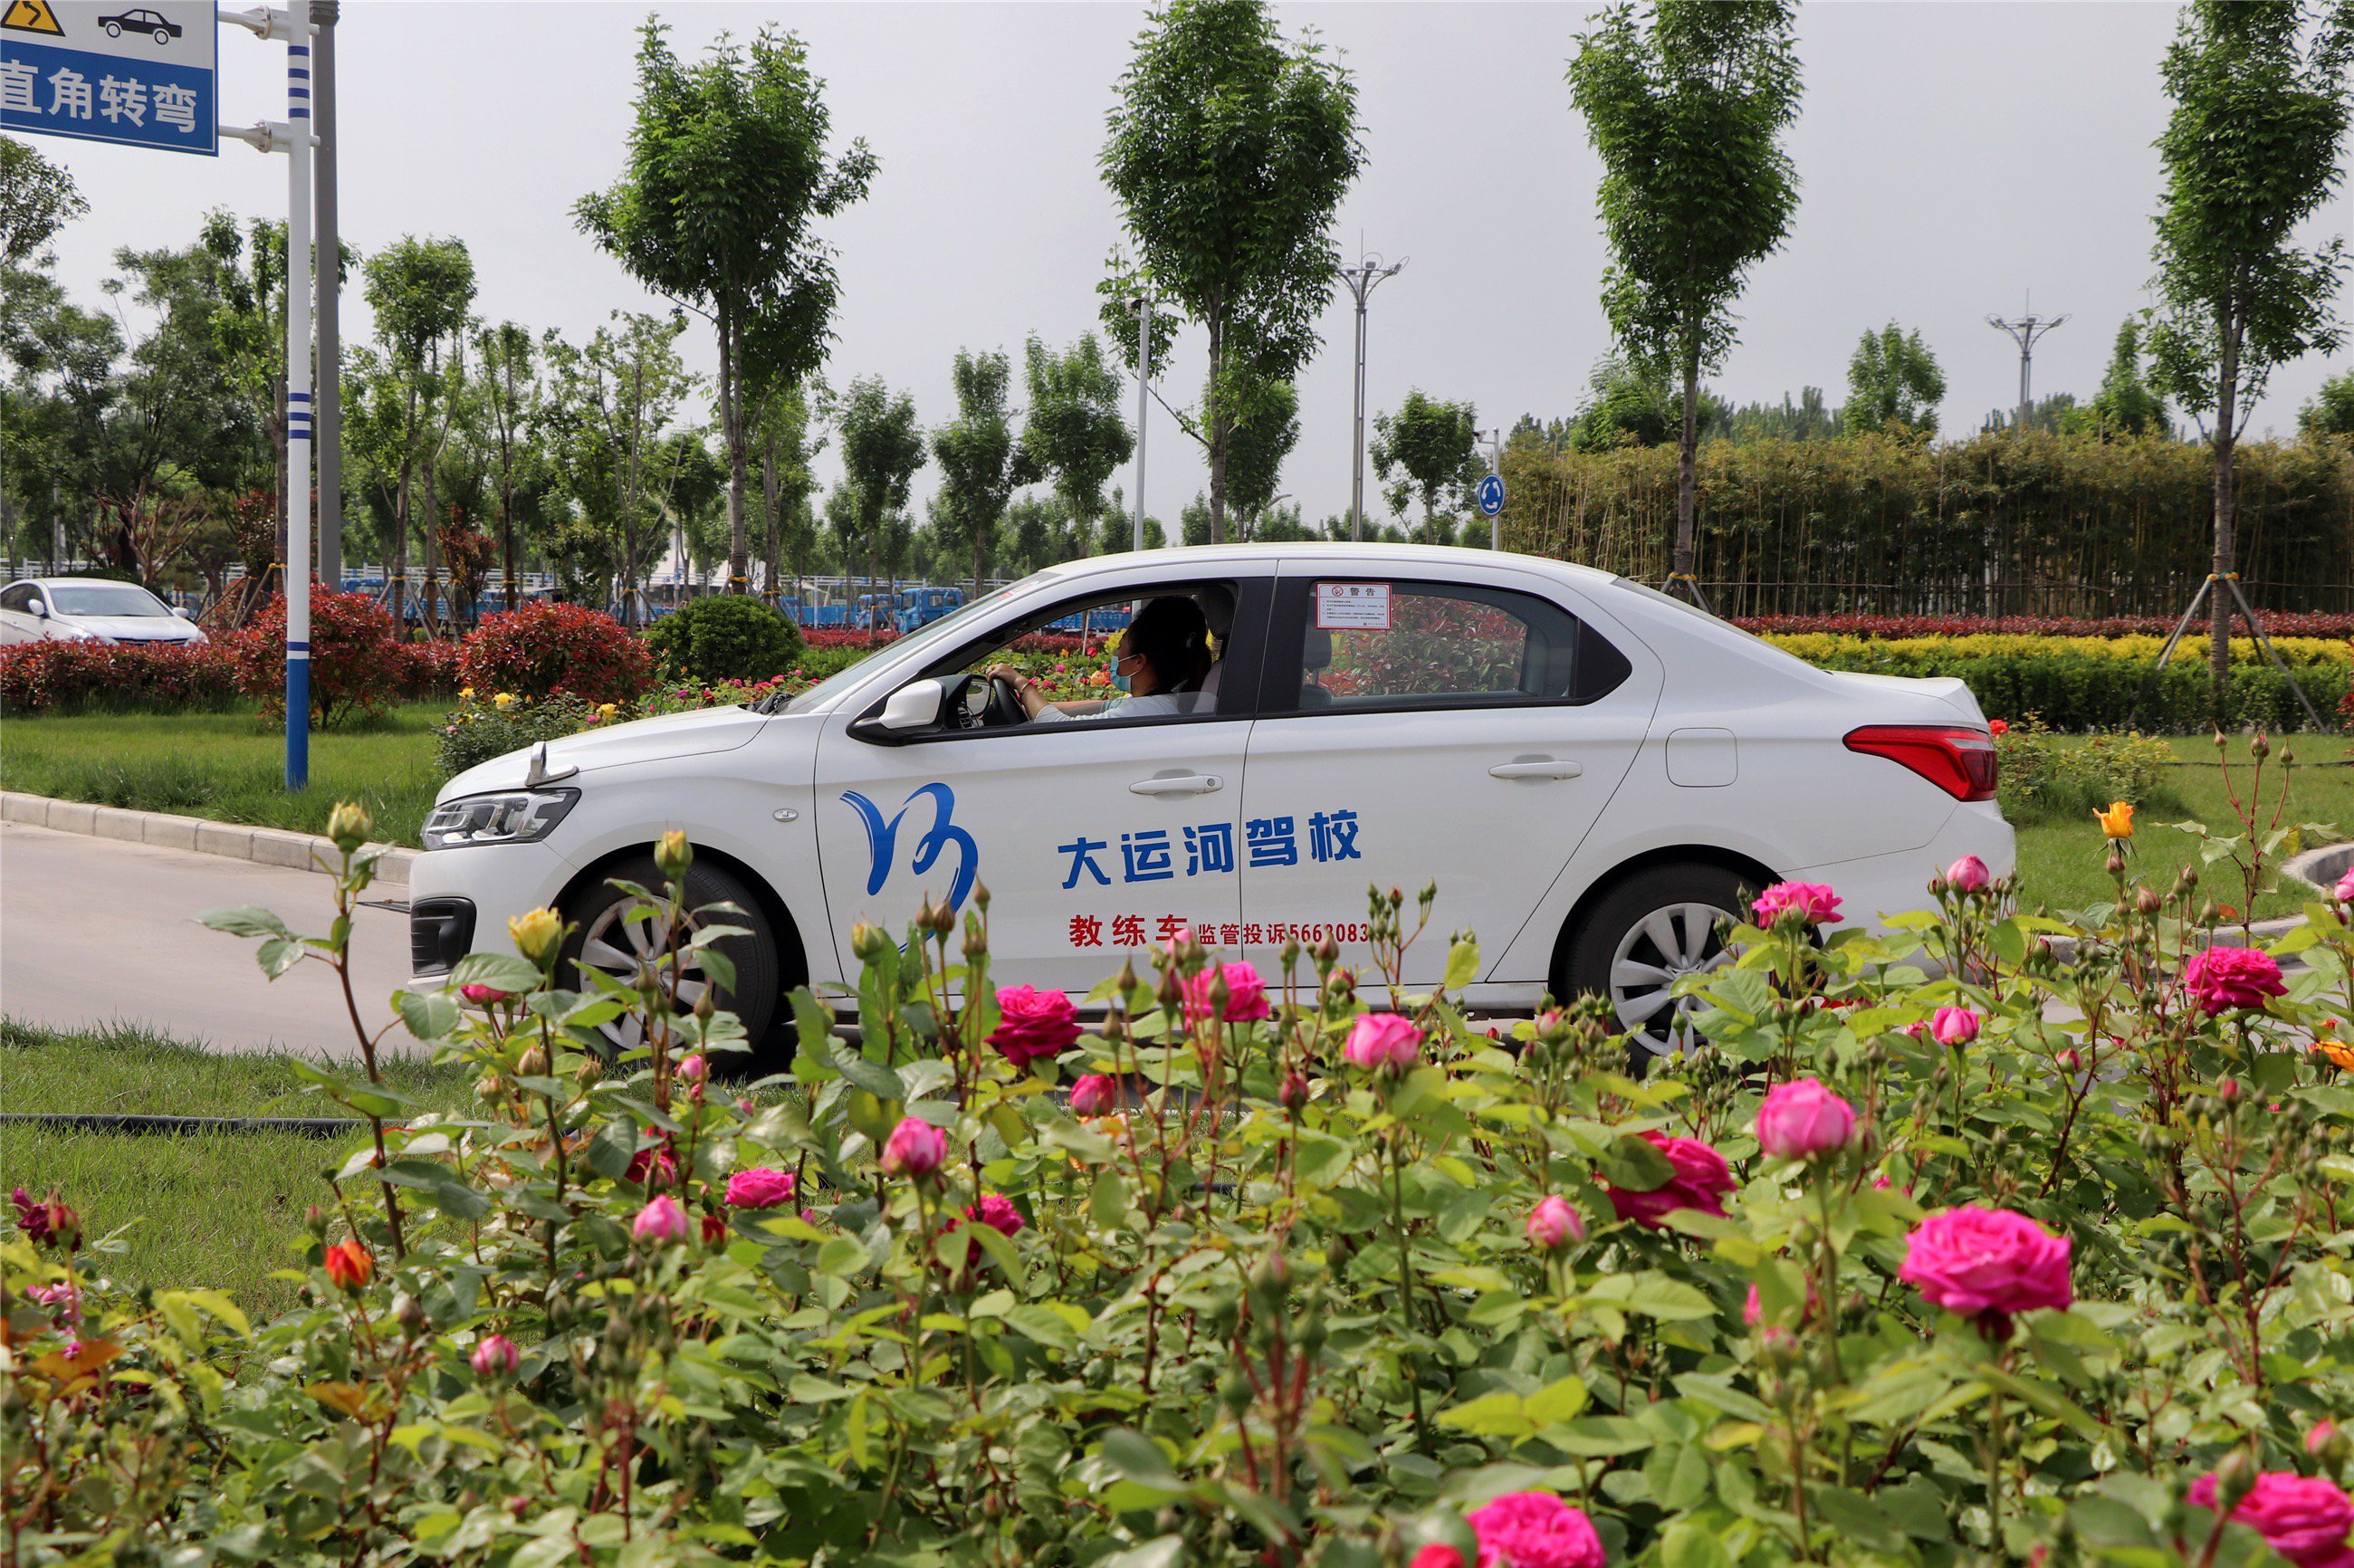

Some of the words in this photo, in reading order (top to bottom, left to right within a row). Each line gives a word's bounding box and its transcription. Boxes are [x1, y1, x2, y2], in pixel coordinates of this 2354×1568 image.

[0, 59, 197, 133] 直角转弯
[1057, 809, 1361, 889] 大运河驾校
[1069, 914, 1187, 947] 教练车
